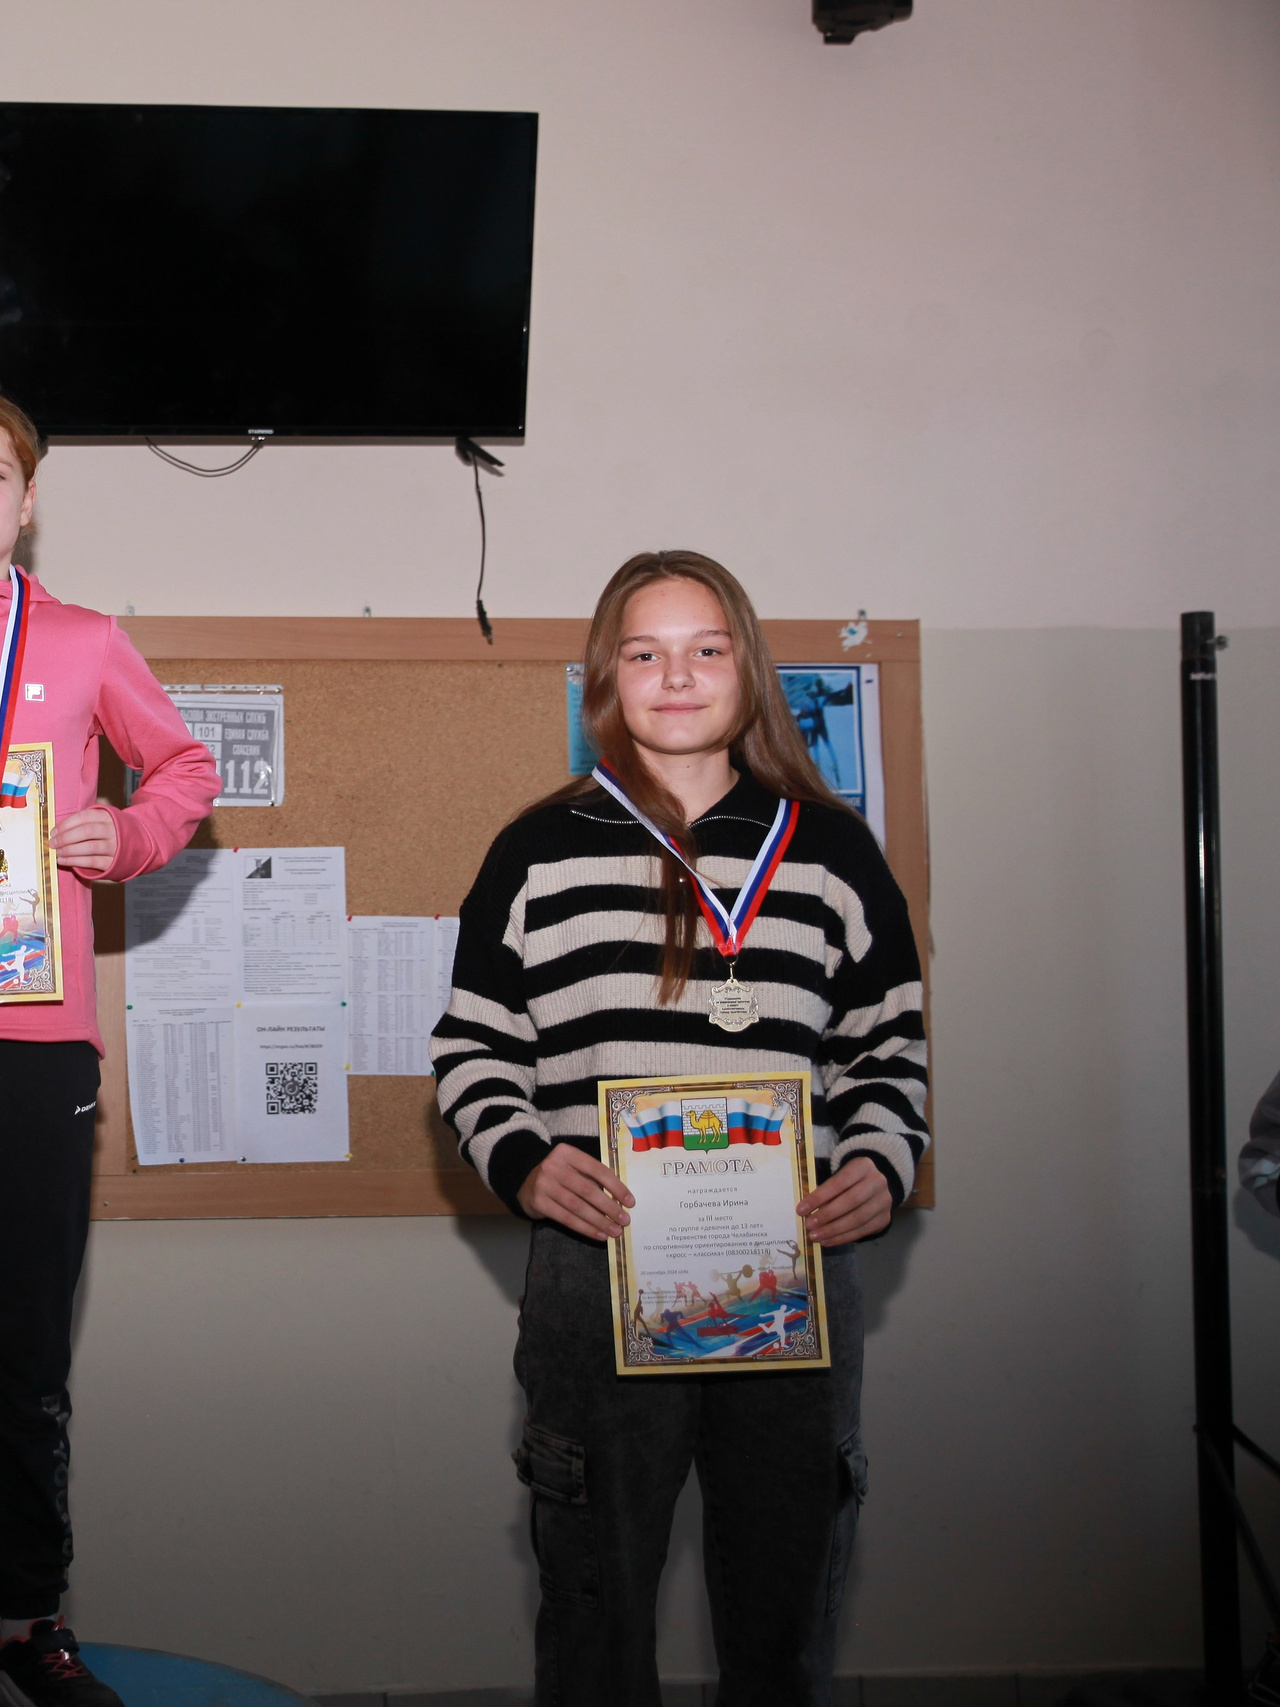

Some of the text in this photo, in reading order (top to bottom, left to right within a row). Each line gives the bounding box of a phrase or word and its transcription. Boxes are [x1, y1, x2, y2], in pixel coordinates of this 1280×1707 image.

[246, 711, 266, 724] СЛУЖБ
[198, 726, 216, 738] 101
[224, 728, 269, 740] ЕДИНАЯ СЛУЖБА
[224, 760, 268, 794] 112
[662, 1159, 755, 1176] ГРАМОТА
[680, 1200, 748, 1209] Горбачева Ирина
